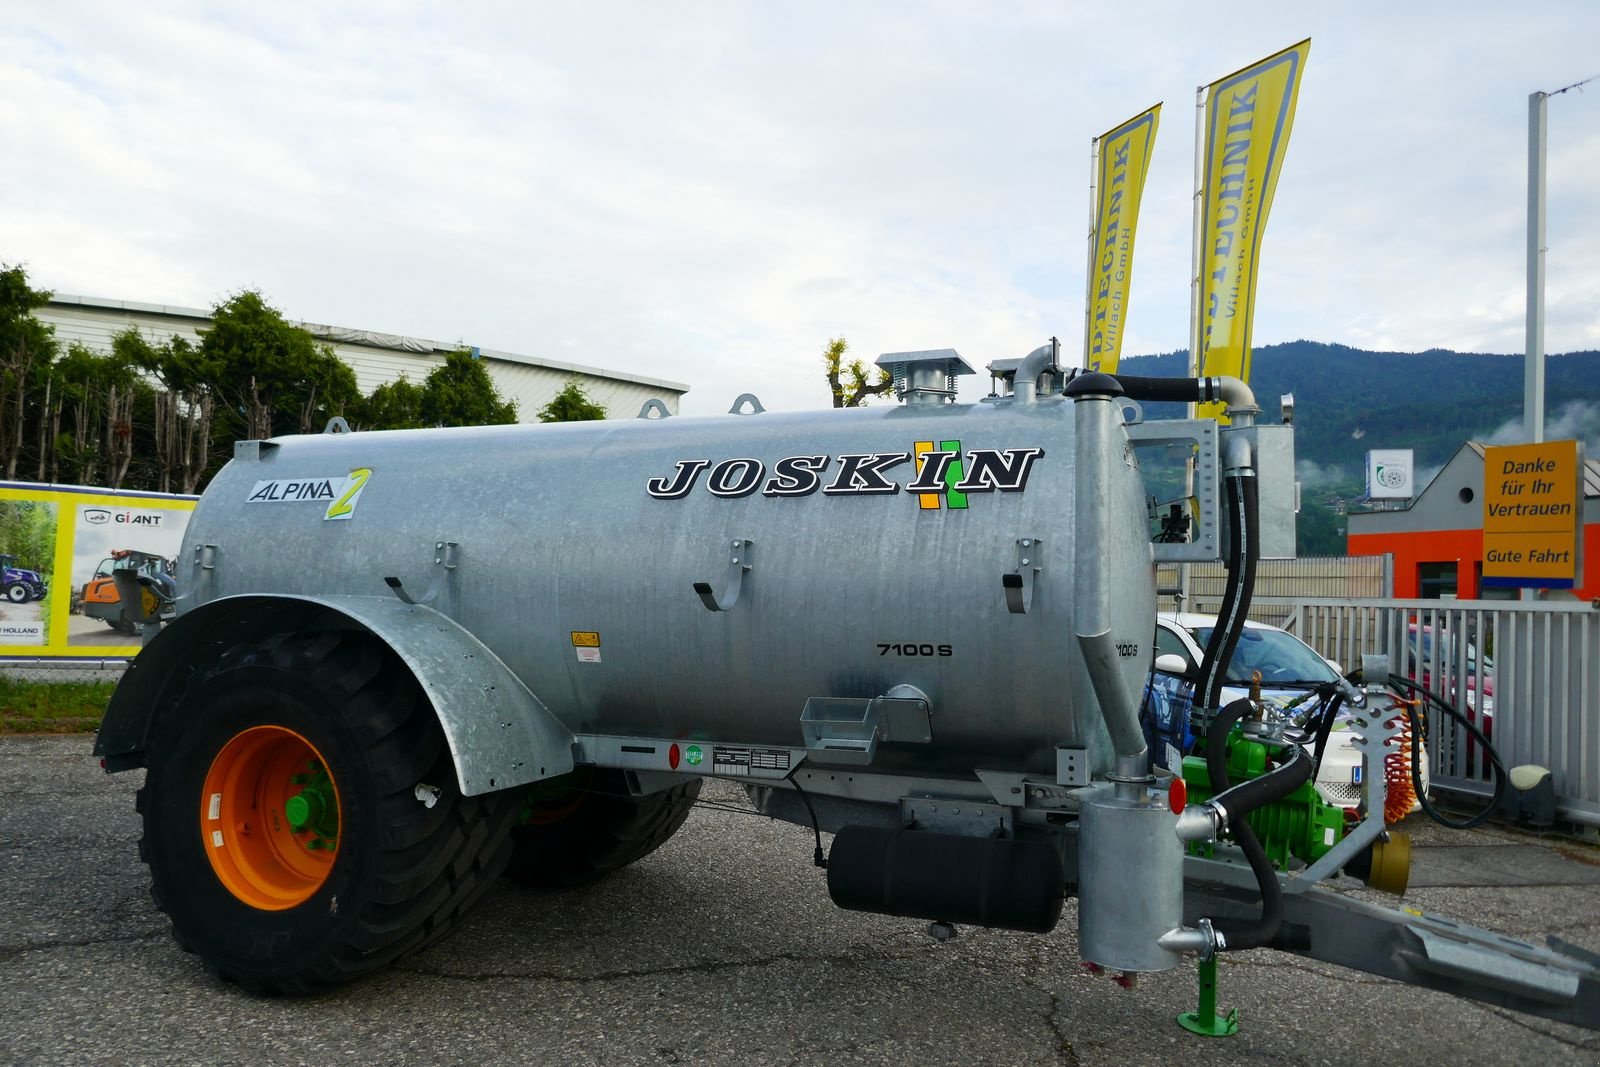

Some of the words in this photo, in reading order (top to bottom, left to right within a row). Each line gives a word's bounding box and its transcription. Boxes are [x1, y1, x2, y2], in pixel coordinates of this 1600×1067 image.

[1105, 291, 1122, 352] Villach
[1115, 228, 1131, 282] GmbH
[1225, 249, 1246, 318] Villach
[646, 447, 1045, 500] JOSKIN
[1503, 458, 1556, 475] Danke
[249, 479, 335, 501] ALPINA
[327, 467, 373, 519] 2
[1501, 480, 1525, 496] für
[1531, 479, 1555, 494] Ihr
[1488, 503, 1571, 517] Vertrauen
[1486, 549, 1522, 563] Gute
[1528, 548, 1570, 563] Fahrt
